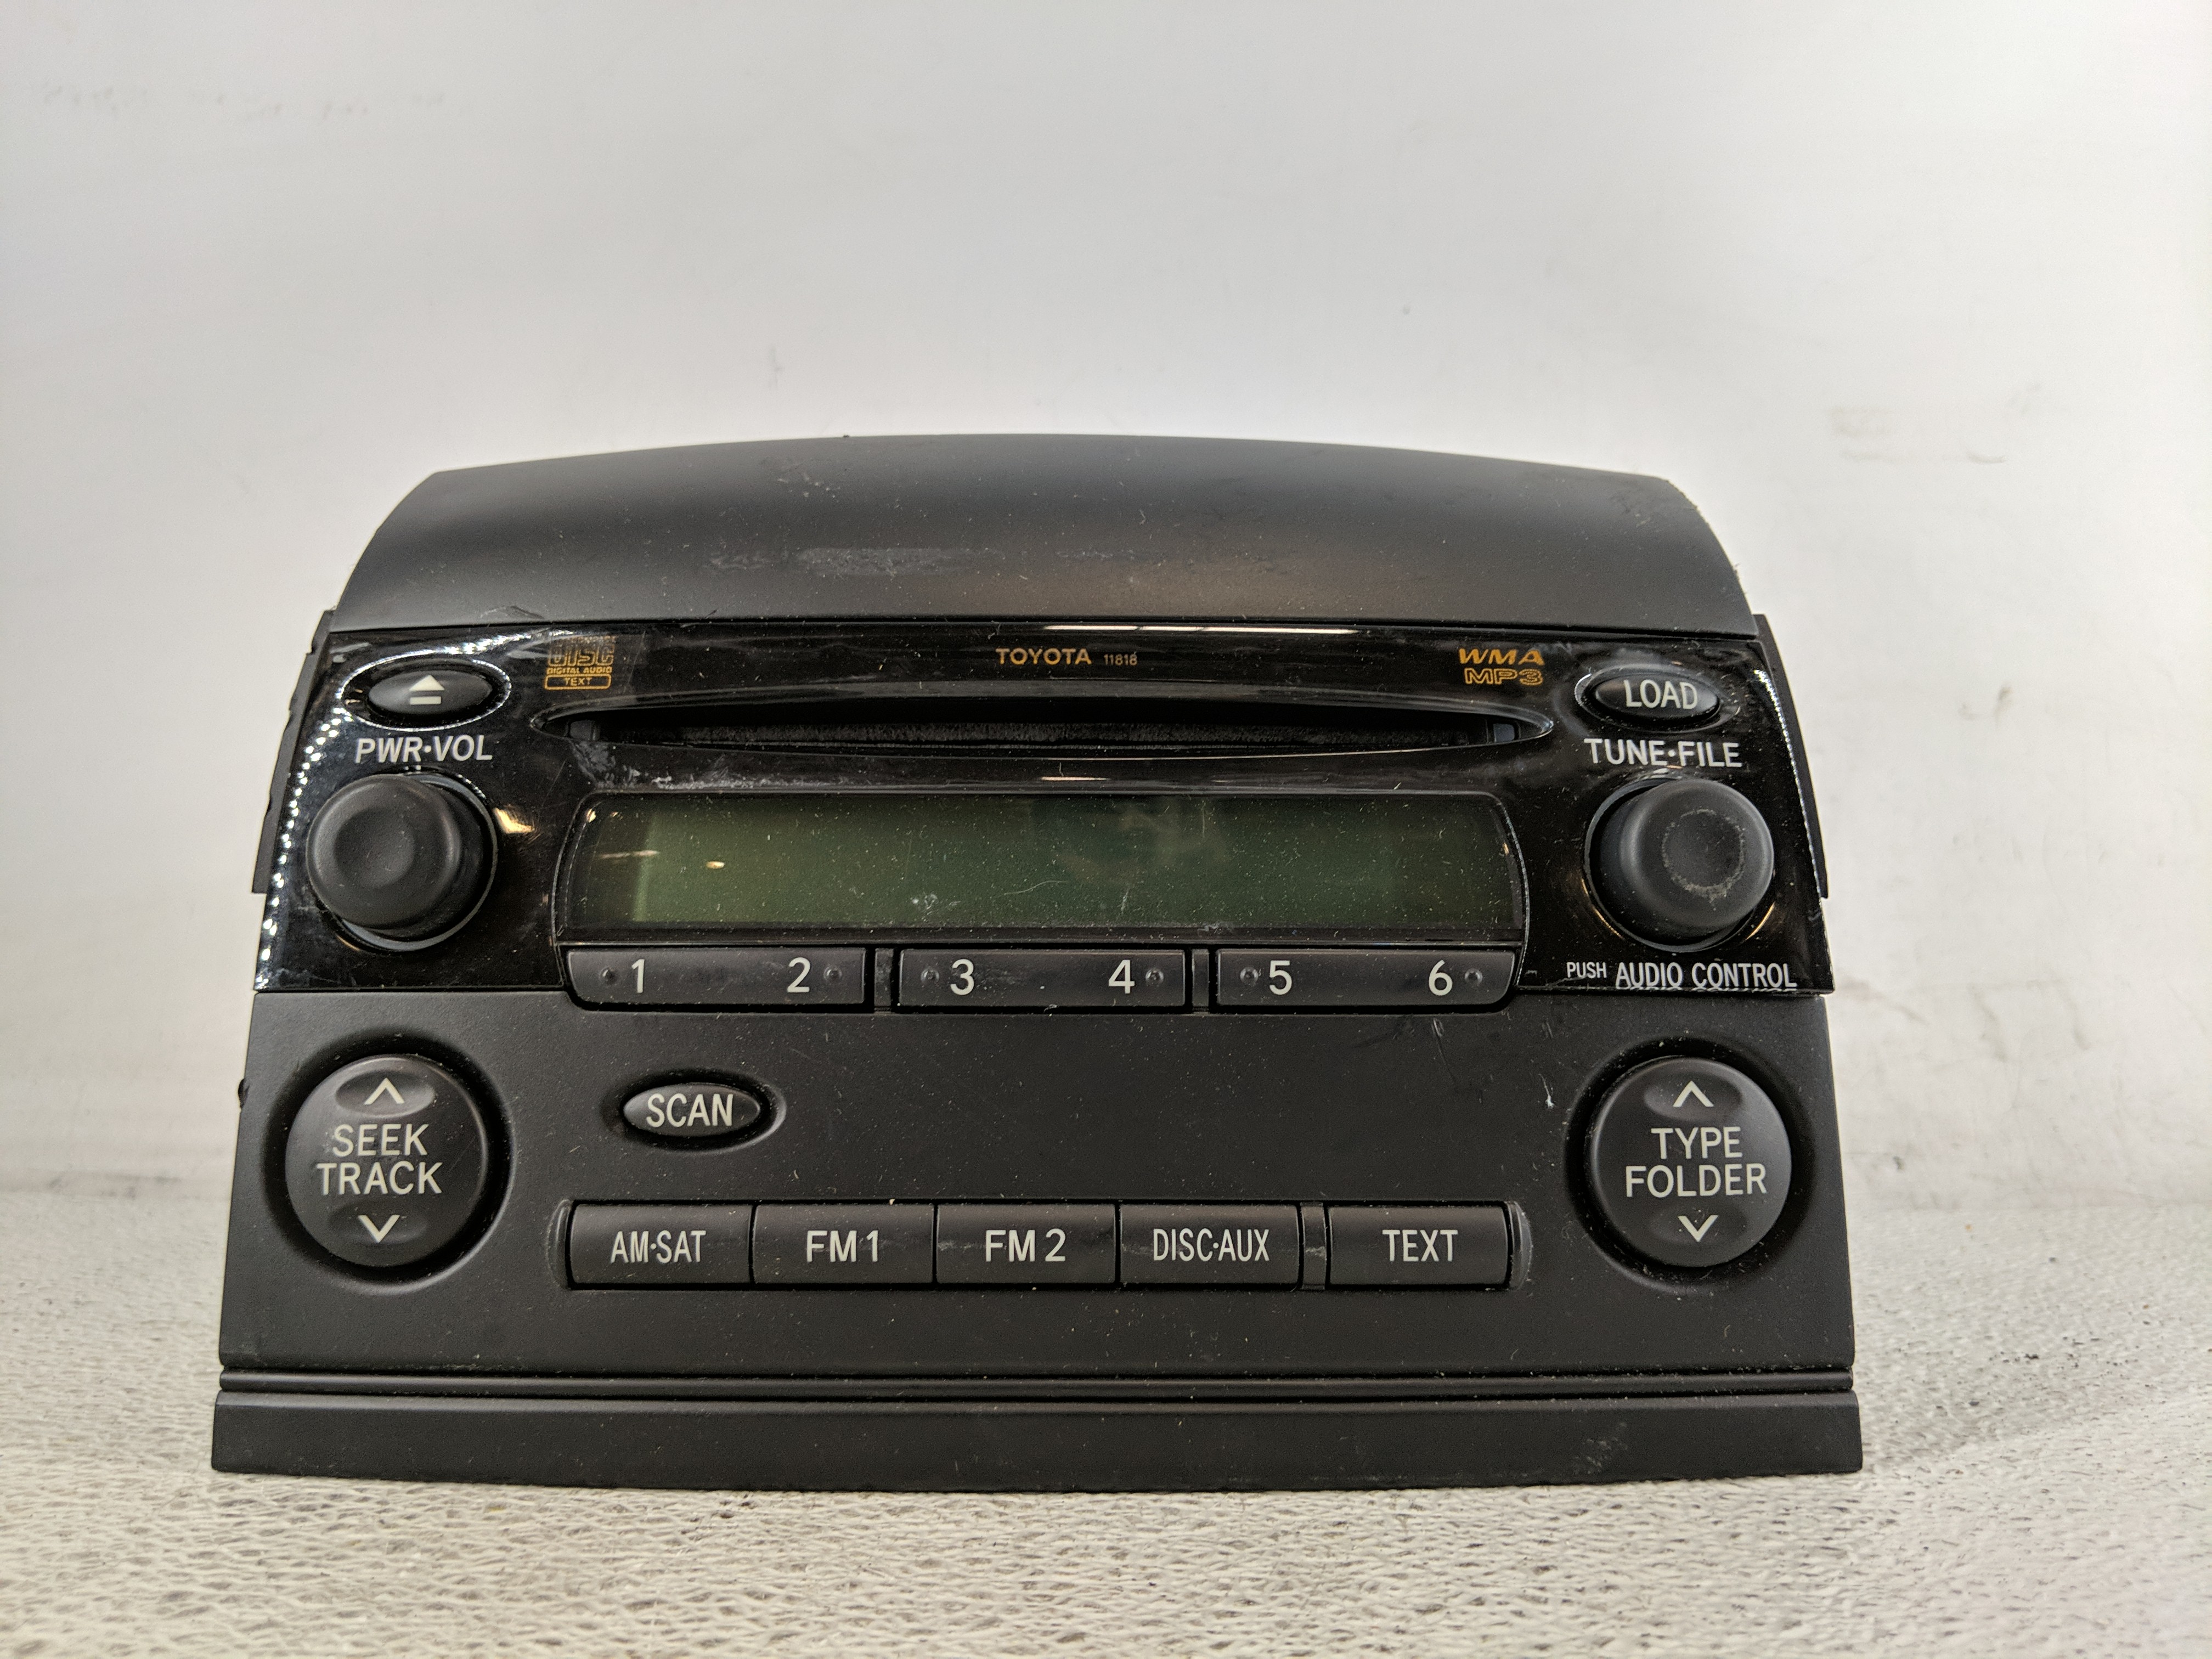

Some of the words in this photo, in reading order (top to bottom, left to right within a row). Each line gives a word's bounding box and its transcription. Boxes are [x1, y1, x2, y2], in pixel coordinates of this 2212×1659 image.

[996, 648, 1091, 664] TOYOTA
[1104, 654, 1137, 665] 11818
[1459, 648, 1544, 665] WMA
[565, 677, 592, 685] TEXT
[1464, 668, 1543, 685] MP3
[1624, 680, 1698, 709] LOAD
[632, 959, 644, 992] 1
[787, 957, 810, 992] 2
[951, 959, 974, 995] 3
[1109, 960, 1135, 993] 4
[1270, 961, 1291, 995] 5
[1429, 960, 1452, 995] 6
[1567, 962, 1606, 979] PUSH
[1616, 963, 1683, 988] AUDIO
[1692, 963, 1797, 988] CONTROL
[646, 1093, 733, 1127] SCAN
[332, 1123, 428, 1157] SEEK
[1651, 1127, 1742, 1159] TYPE
[317, 1161, 442, 1195] TRACK
[1626, 1164, 1767, 1197] FOLDER
[1383, 1230, 1458, 1261] TEXT
